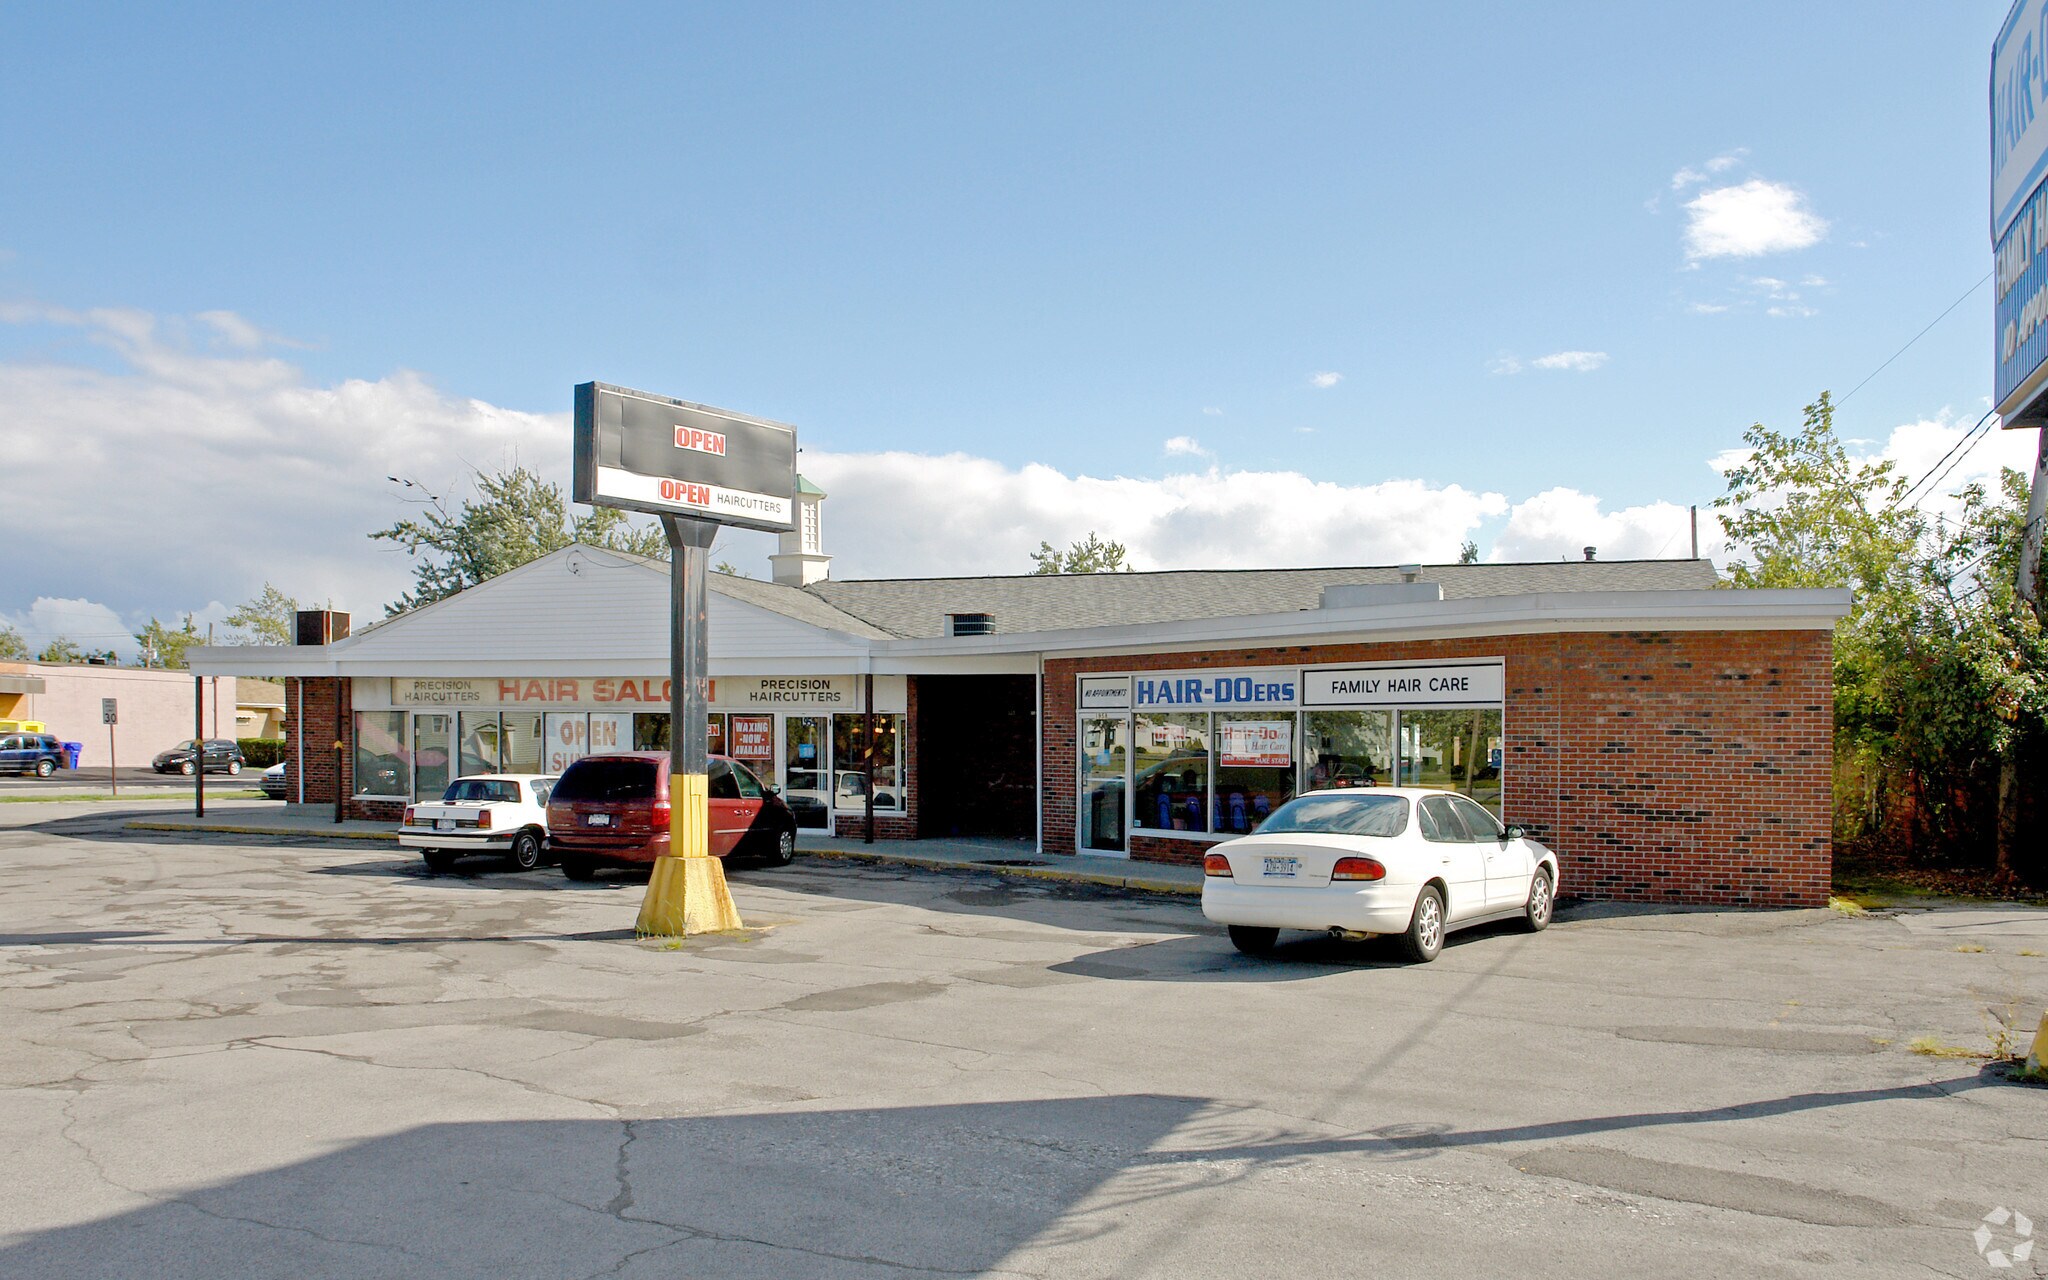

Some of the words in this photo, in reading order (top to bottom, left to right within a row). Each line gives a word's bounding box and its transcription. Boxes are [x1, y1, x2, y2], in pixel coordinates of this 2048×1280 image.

[1998, 208, 2033, 304] FAMILY
[2036, 190, 2048, 256] H
[676, 427, 724, 454] OPEN
[661, 480, 710, 505] OPEN
[717, 493, 781, 514] HAIRCUTTERS
[414, 680, 471, 690] PRECISION
[498, 679, 579, 701] HAIR
[593, 679, 716, 702] SAL
[761, 680, 830, 690] PRECISION
[1332, 680, 1381, 694] FAMILY
[1388, 679, 1421, 692] HAIR
[1429, 677, 1469, 691] CARE
[404, 691, 480, 701] HAIRCUTTERS
[750, 691, 841, 702] HAIRCUTTERS
[1092, 689, 1127, 697] APPOINTMENTS
[105, 713, 116, 722] 30
[560, 720, 617, 746] OPEN
[735, 722, 768, 733] WAXING
[735, 745, 770, 755] AVAILABLE
[552, 751, 583, 772] SU
